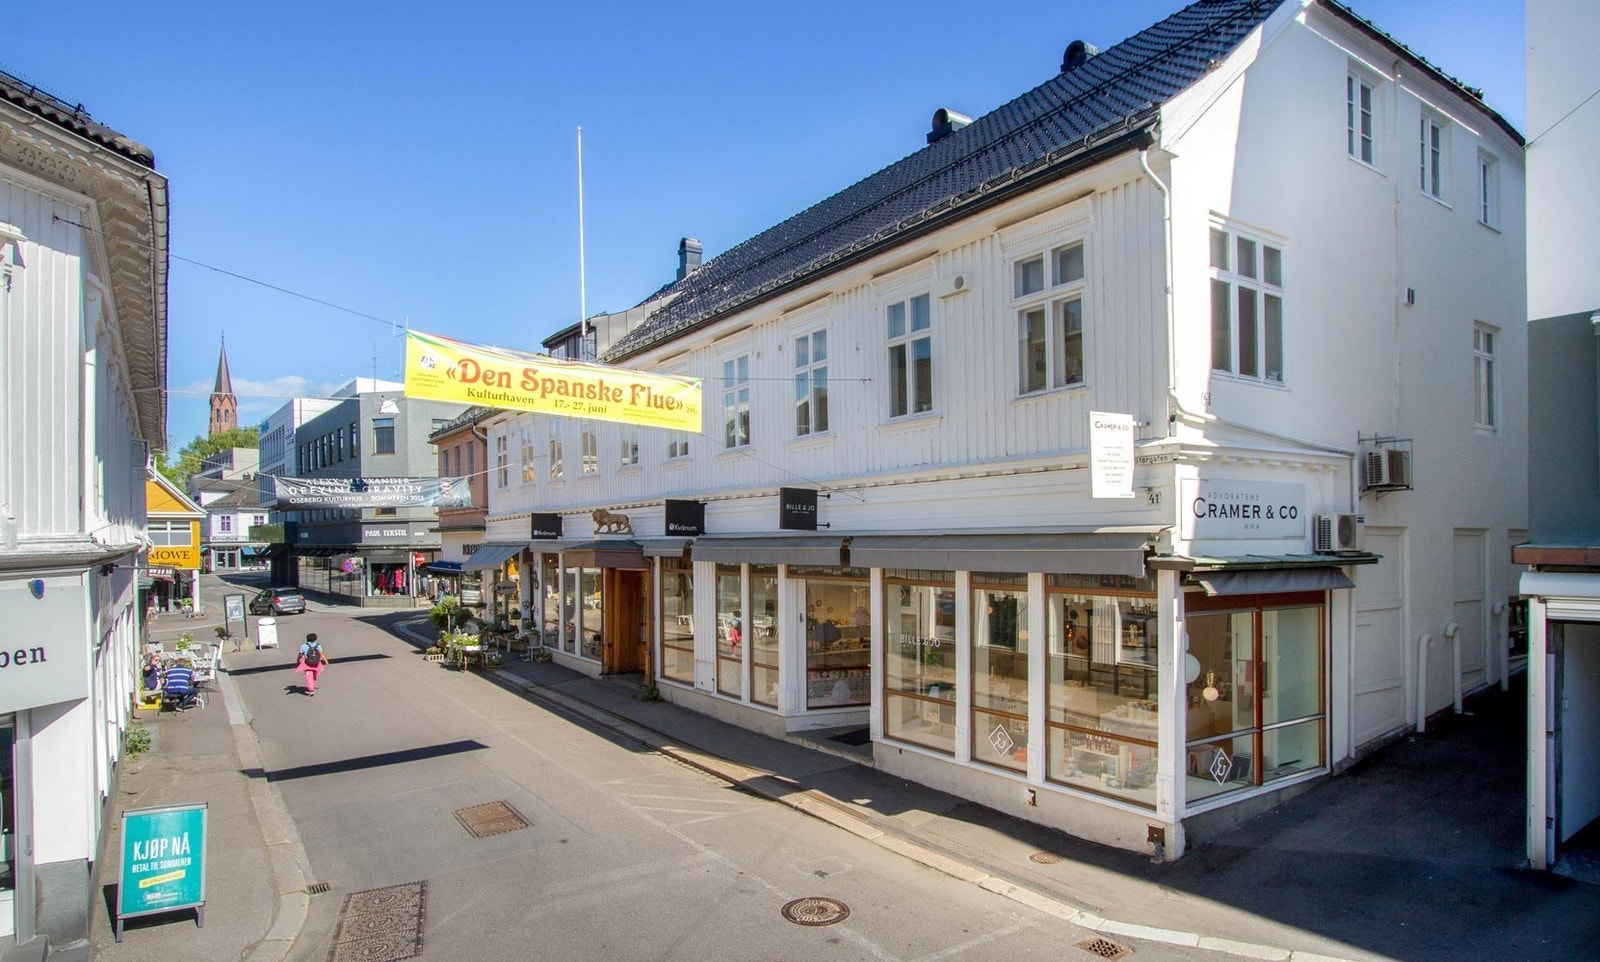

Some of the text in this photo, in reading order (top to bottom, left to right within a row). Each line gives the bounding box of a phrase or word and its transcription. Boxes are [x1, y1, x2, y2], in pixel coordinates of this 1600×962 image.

[446, 358, 512, 389] «Den
[520, 367, 623, 403] Spanske
[630, 383, 683, 410] Flue»
[467, 387, 534, 404] Kulturhaven
[588, 403, 607, 414] juni
[1095, 420, 1117, 431] CRAMER
[1133, 454, 1169, 465] Storgaten
[362, 485, 422, 494] GRAVITY
[289, 496, 323, 504] OSEBERG
[1148, 493, 1160, 504] 41
[1208, 492, 1260, 501] ADVOKATENE
[785, 503, 801, 511] BILLE
[1193, 496, 1298, 519] CRAMER & CO
[365, 529, 381, 537] PAUL
[900, 634, 921, 645] BILLE
[133, 831, 191, 861] KJØP NÅ
[132, 857, 192, 873] BETAL TIL SOMMEREN
